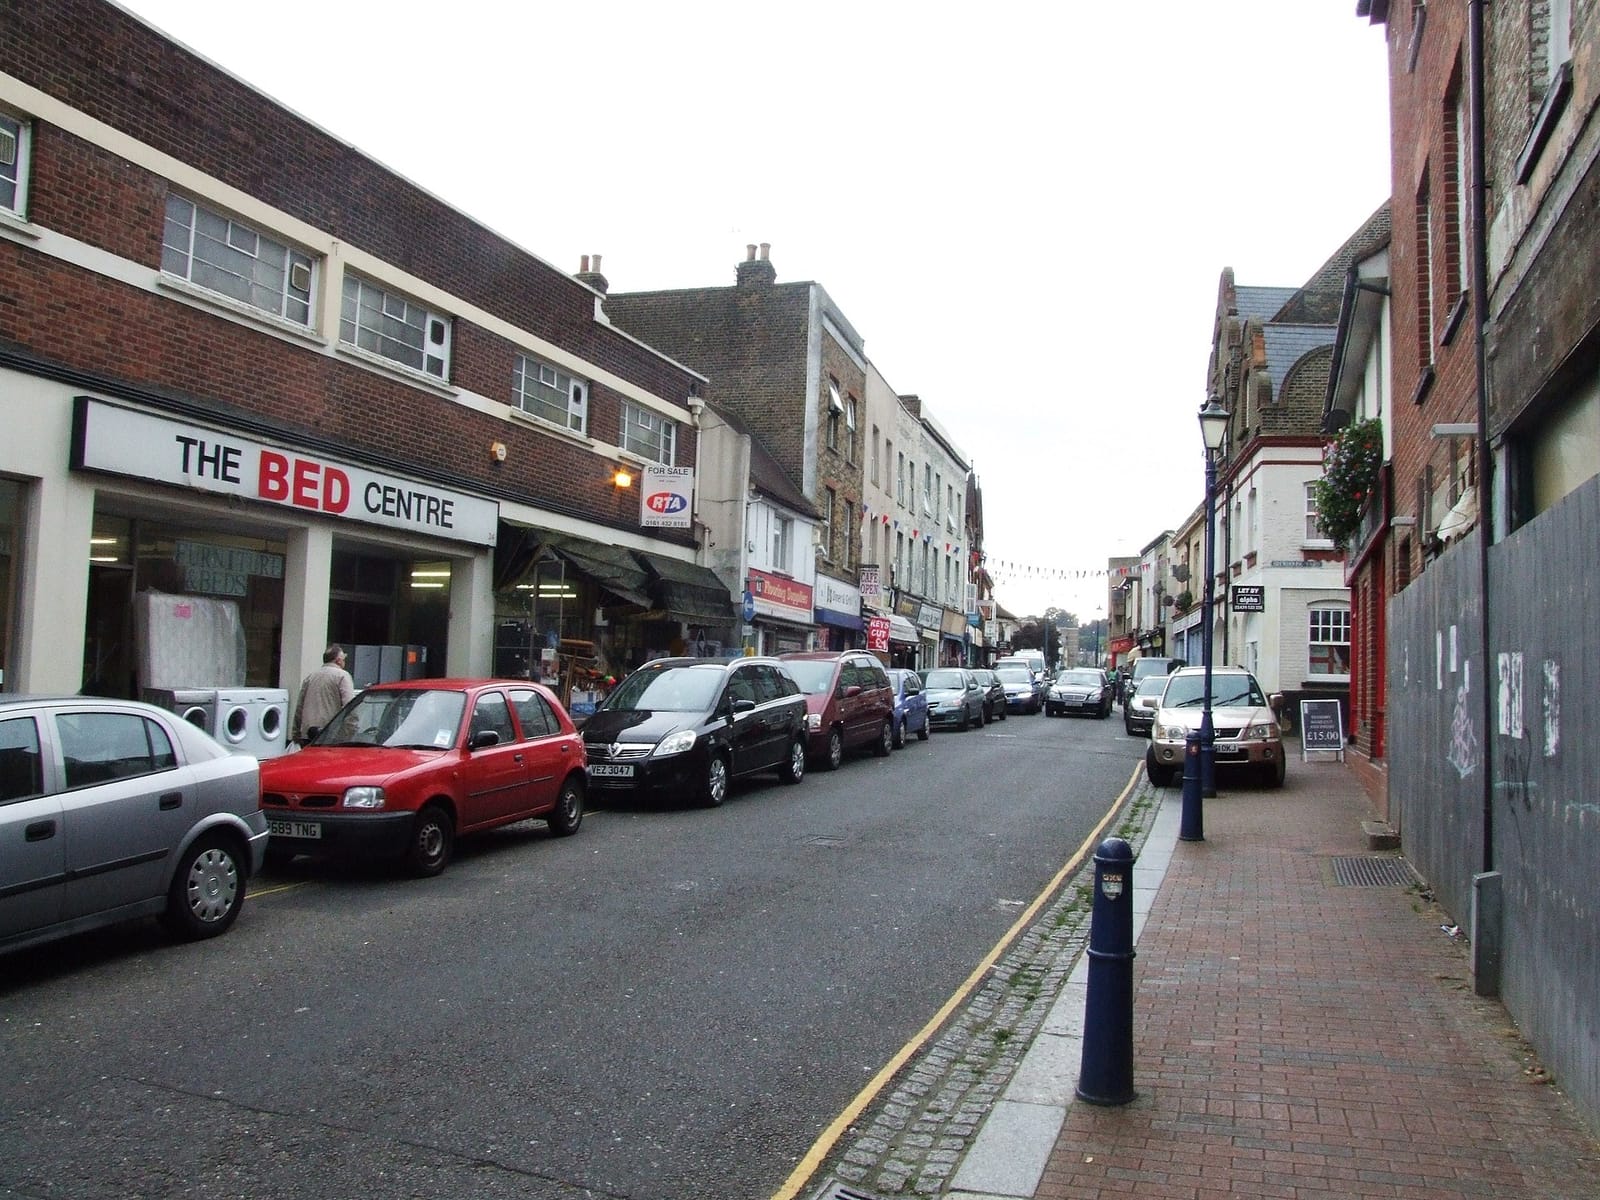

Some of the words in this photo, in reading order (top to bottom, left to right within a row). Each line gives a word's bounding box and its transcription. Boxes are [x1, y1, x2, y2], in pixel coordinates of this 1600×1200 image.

[648, 467, 665, 475] FOR
[667, 468, 689, 476] SALE
[175, 435, 242, 484] THE
[258, 450, 351, 514] BED
[364, 481, 455, 529] CENTRE
[652, 496, 681, 510] RTA
[175, 542, 282, 578] FURNITURE
[860, 571, 879, 583] CAFE
[861, 584, 879, 595] OPEN
[870, 619, 890, 629] KEYS
[871, 629, 886, 638] CUT
[1307, 731, 1339, 741] £15.00
[608, 766, 630, 775] 3047
[295, 823, 317, 837] TNG
